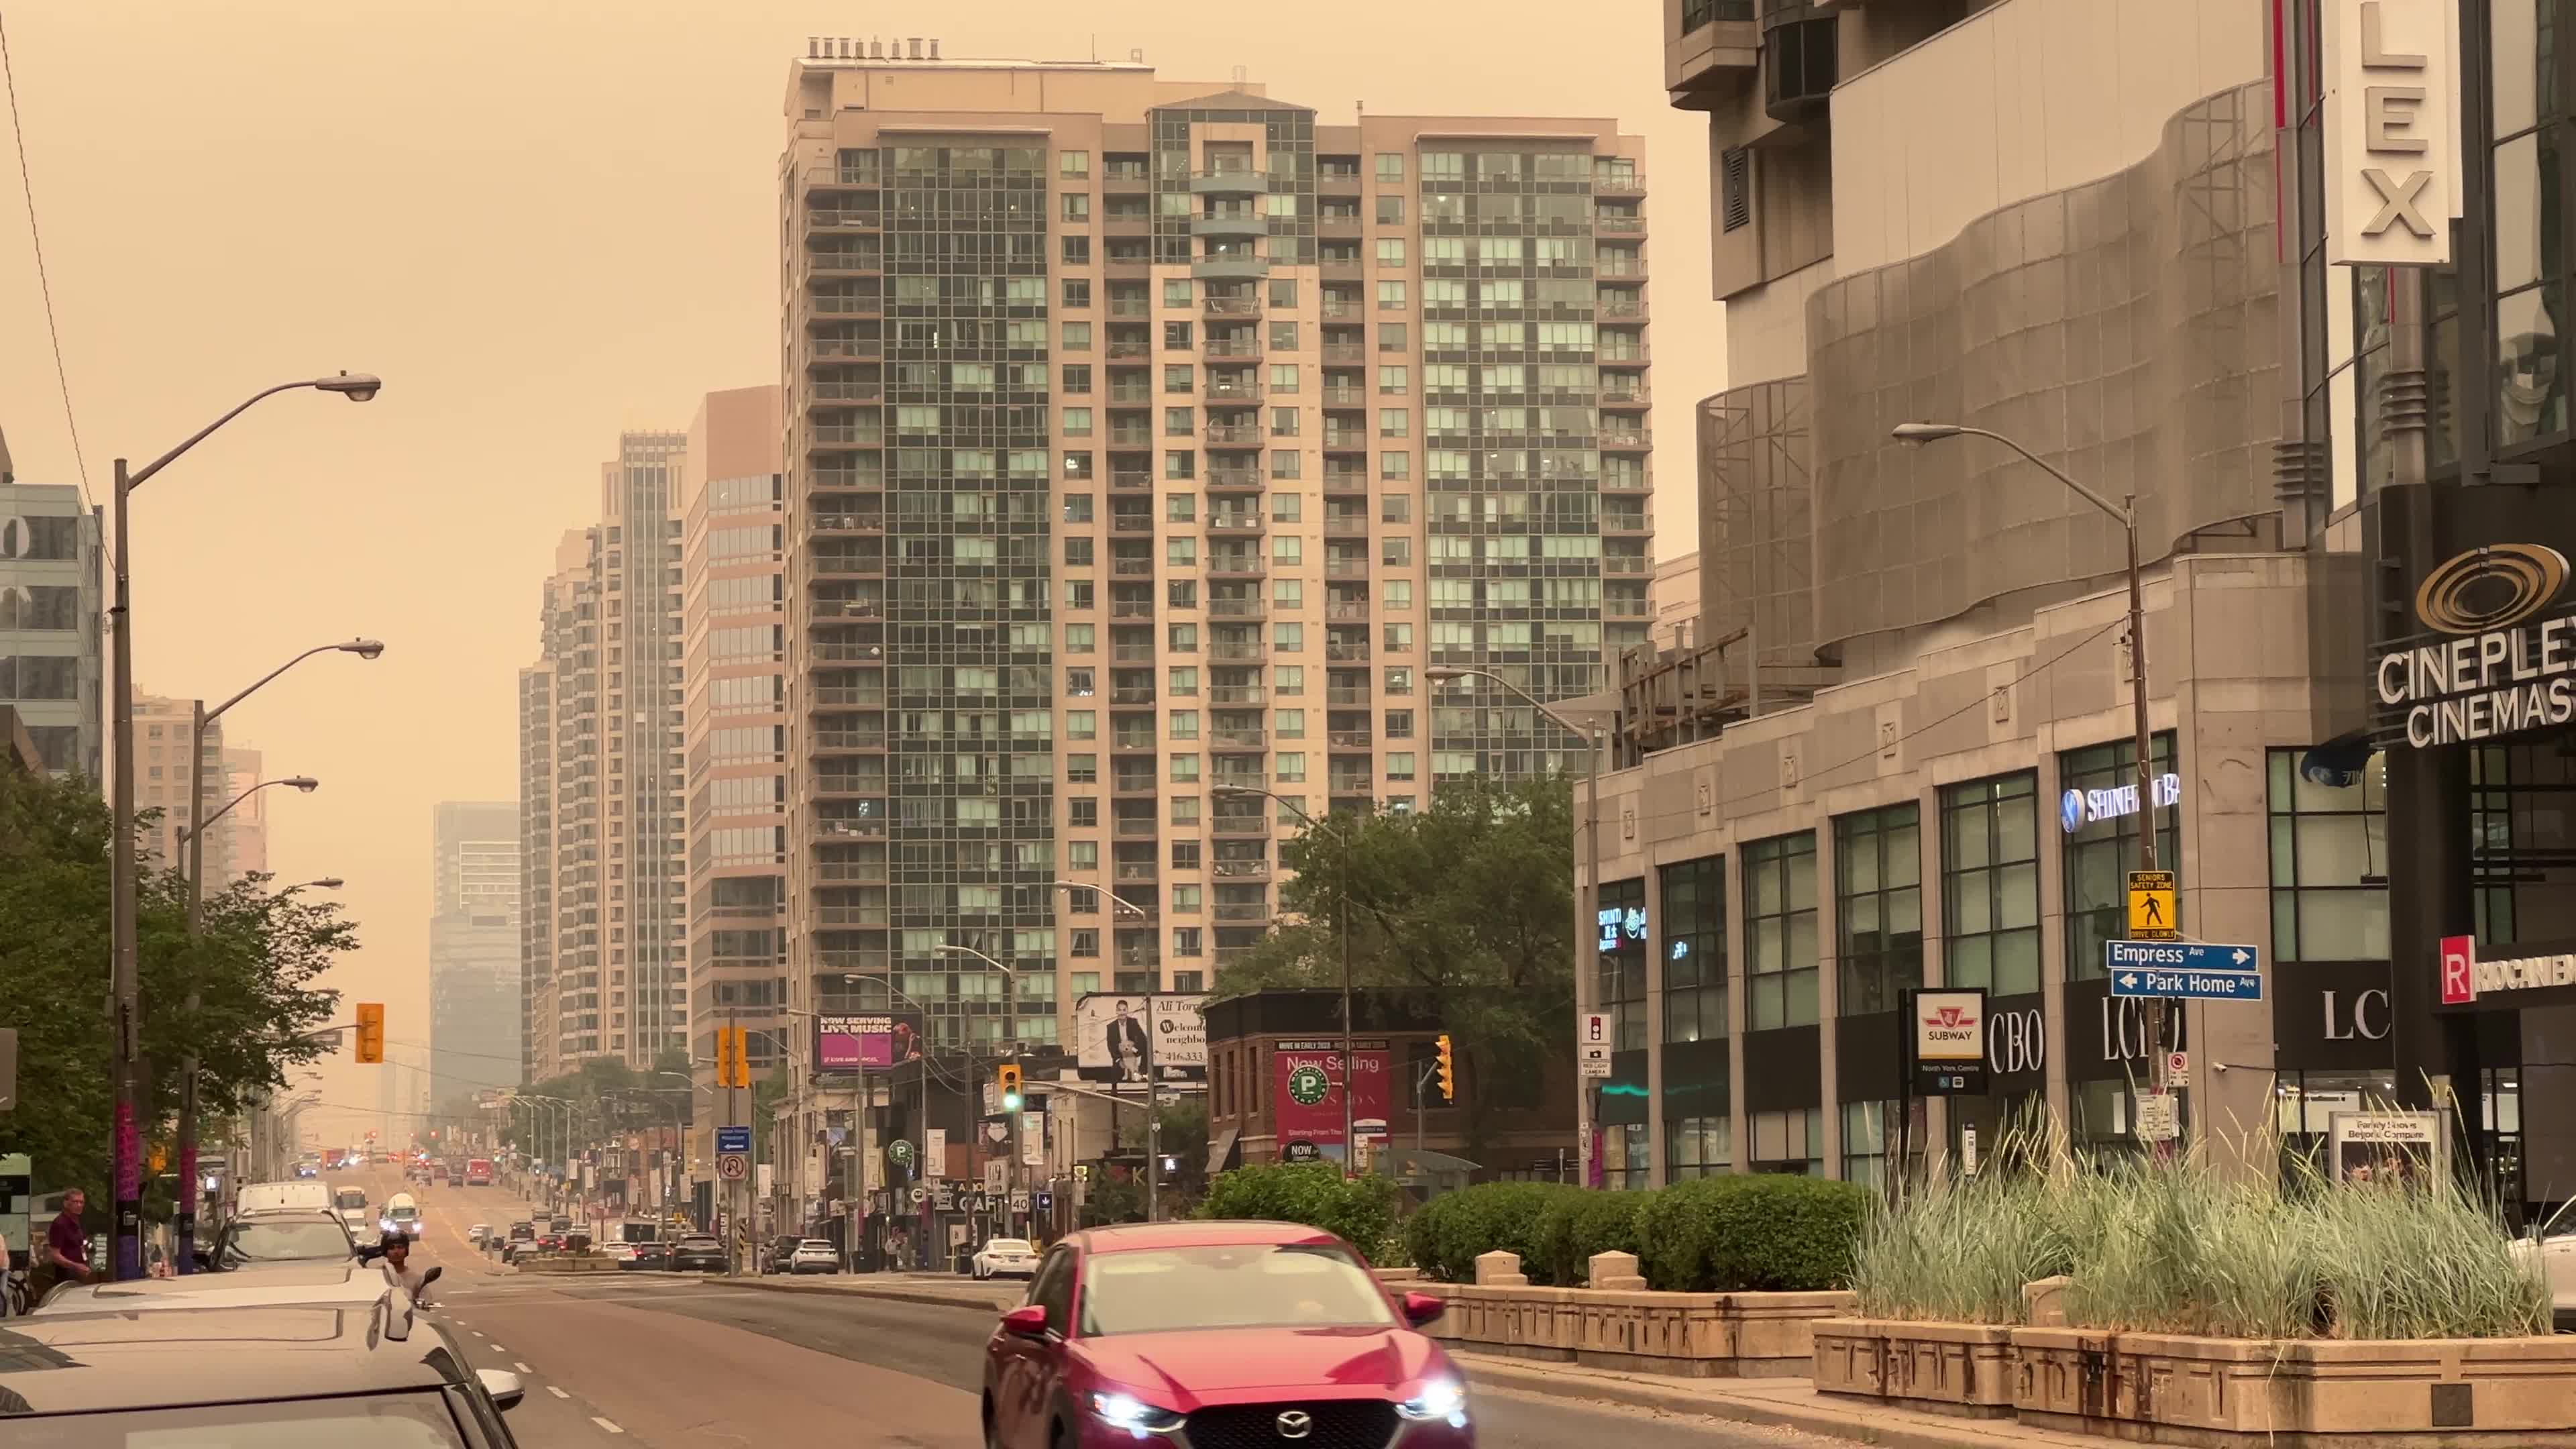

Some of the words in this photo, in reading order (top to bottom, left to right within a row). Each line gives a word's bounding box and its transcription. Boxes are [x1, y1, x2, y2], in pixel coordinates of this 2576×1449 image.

[2378, 616, 2576, 704] CINEPLE
[2407, 678, 2573, 748] CINEMAS
[2137, 874, 2165, 882] SENIORS
[2130, 881, 2153, 890] SAFETY
[2157, 881, 2173, 890] ZONE
[2113, 944, 2184, 966] Empress
[2189, 947, 2204, 957] Ave
[2147, 973, 2184, 991] Park
[2189, 974, 2236, 993] Home
[2239, 977, 2255, 987] Ave
[1157, 1000, 1173, 1012] Ali
[820, 1024, 849, 1034] LIVE
[851, 1024, 892, 1034] MUSIC
[1928, 1030, 1972, 1040] SUBWAY
[1326, 1055, 1379, 1073] Seling
[1301, 1075, 1317, 1091] P
[2383, 1130, 2424, 1140] Compare
[1291, 1145, 1312, 1155] NOW
[1013, 1199, 1027, 1209] 40
